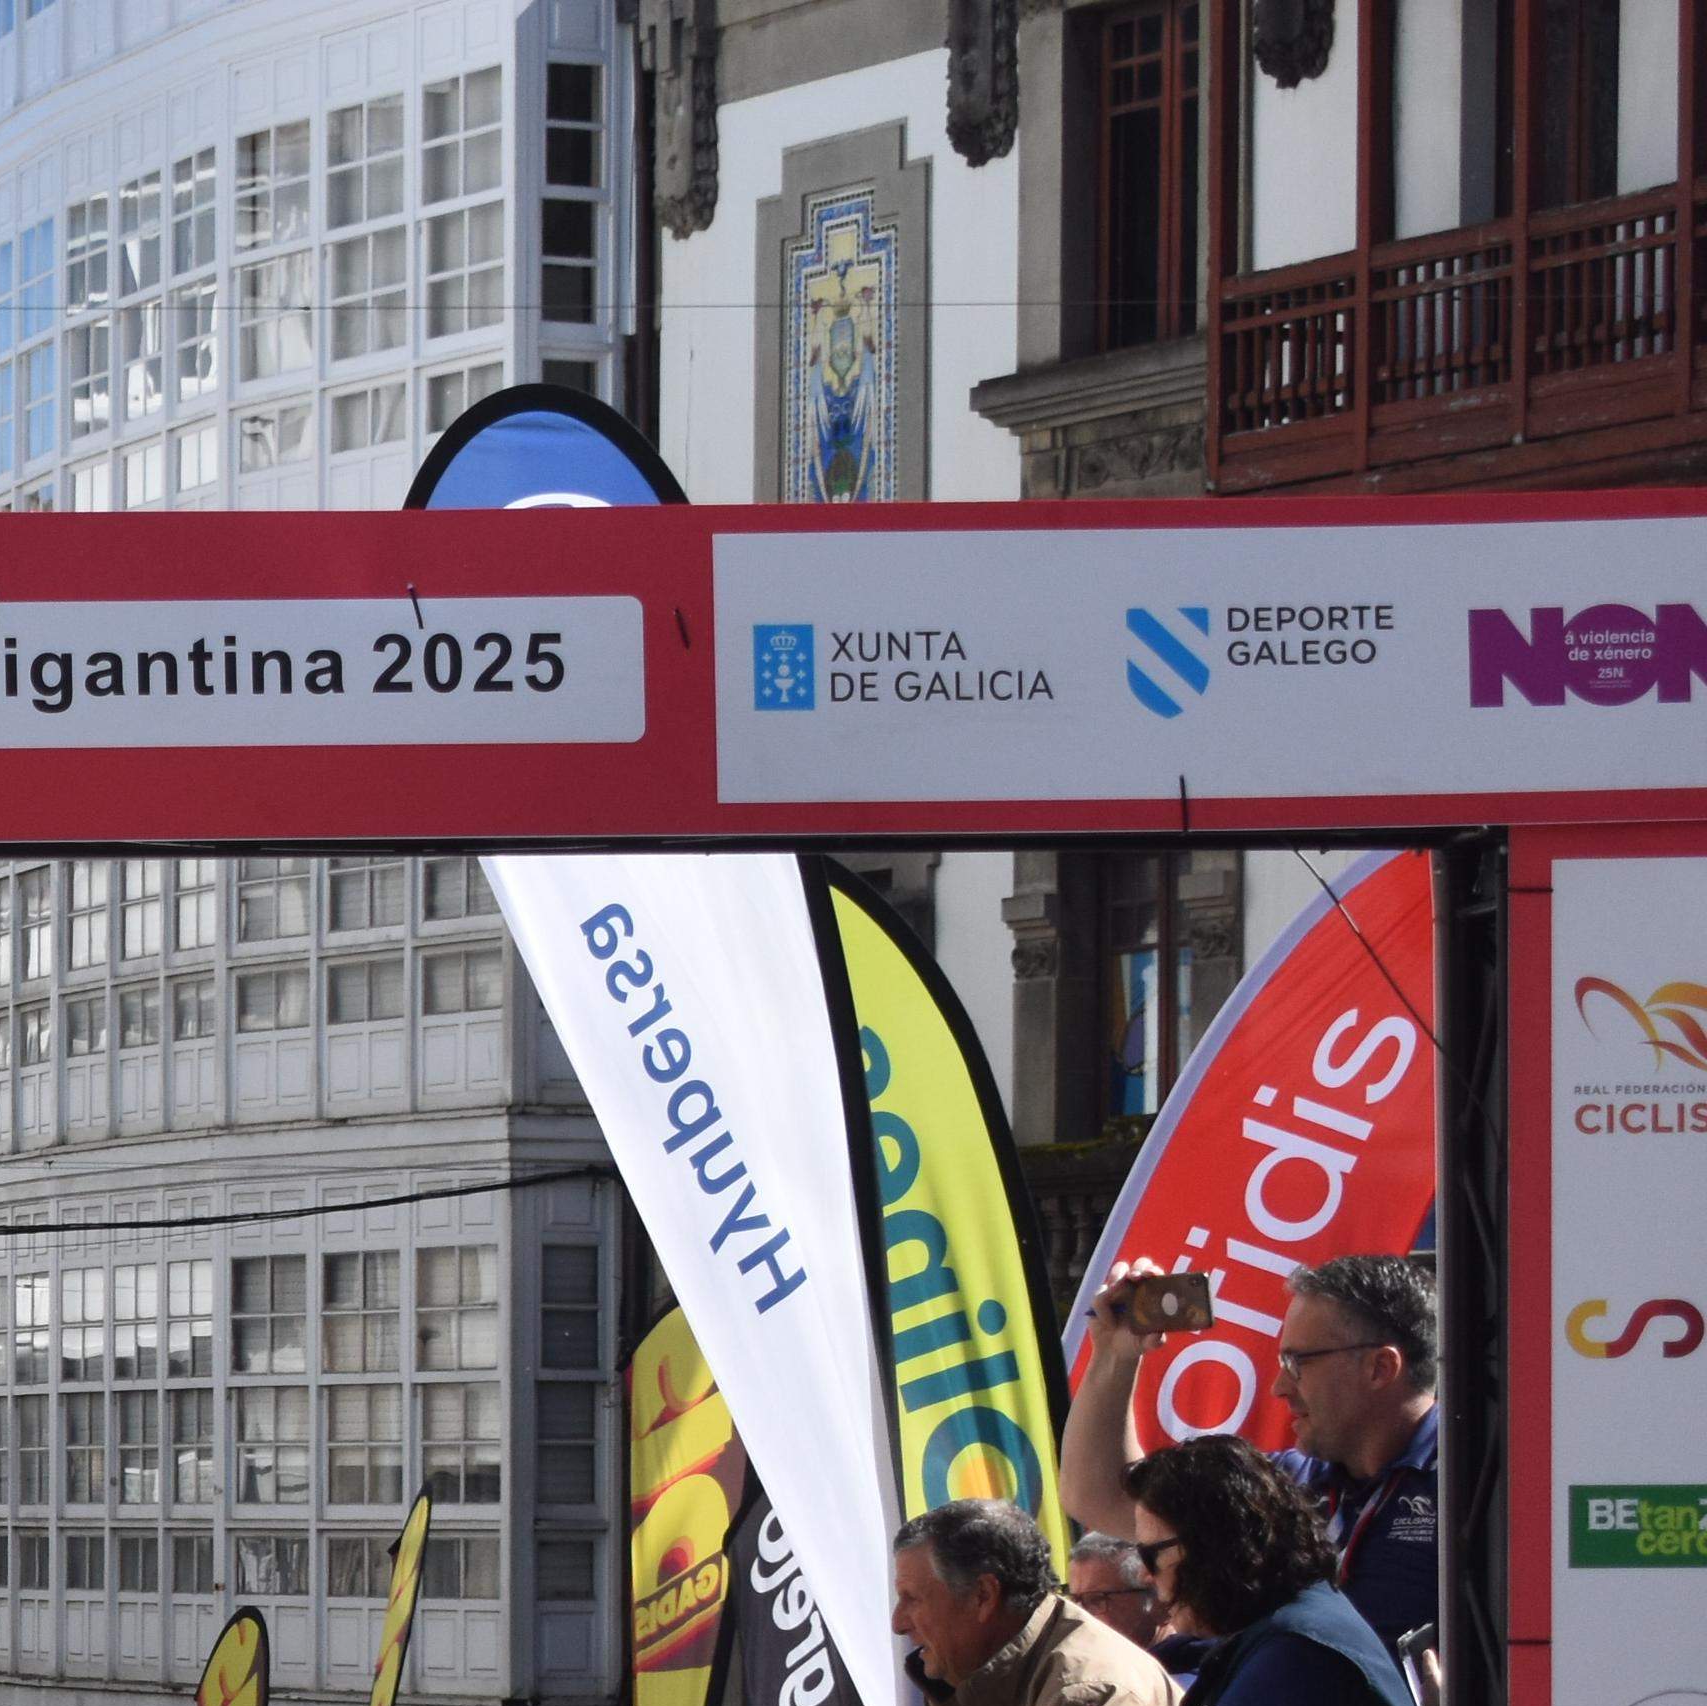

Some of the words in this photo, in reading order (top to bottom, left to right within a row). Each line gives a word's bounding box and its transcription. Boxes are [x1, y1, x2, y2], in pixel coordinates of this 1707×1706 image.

[1227, 604, 1395, 633] DEPORTE
[829, 631, 967, 663] XUNTA
[1565, 630, 1575, 645] á
[1580, 629, 1655, 645] violencia
[371, 630, 566, 695] 2025
[1227, 638, 1377, 667] GALEGO
[1568, 648, 1588, 662] de
[1594, 646, 1651, 661] xénero
[829, 671, 881, 702] DE
[893, 669, 1054, 702] GALICIA
[1597, 667, 1624, 679] 25N
[1574, 1085, 1609, 1095] REAL
[1615, 1083, 1706, 1095] FEDERACIÓN
[1156, 1006, 1418, 1444] ofidis
[1588, 1498, 1707, 1537] BEtan
